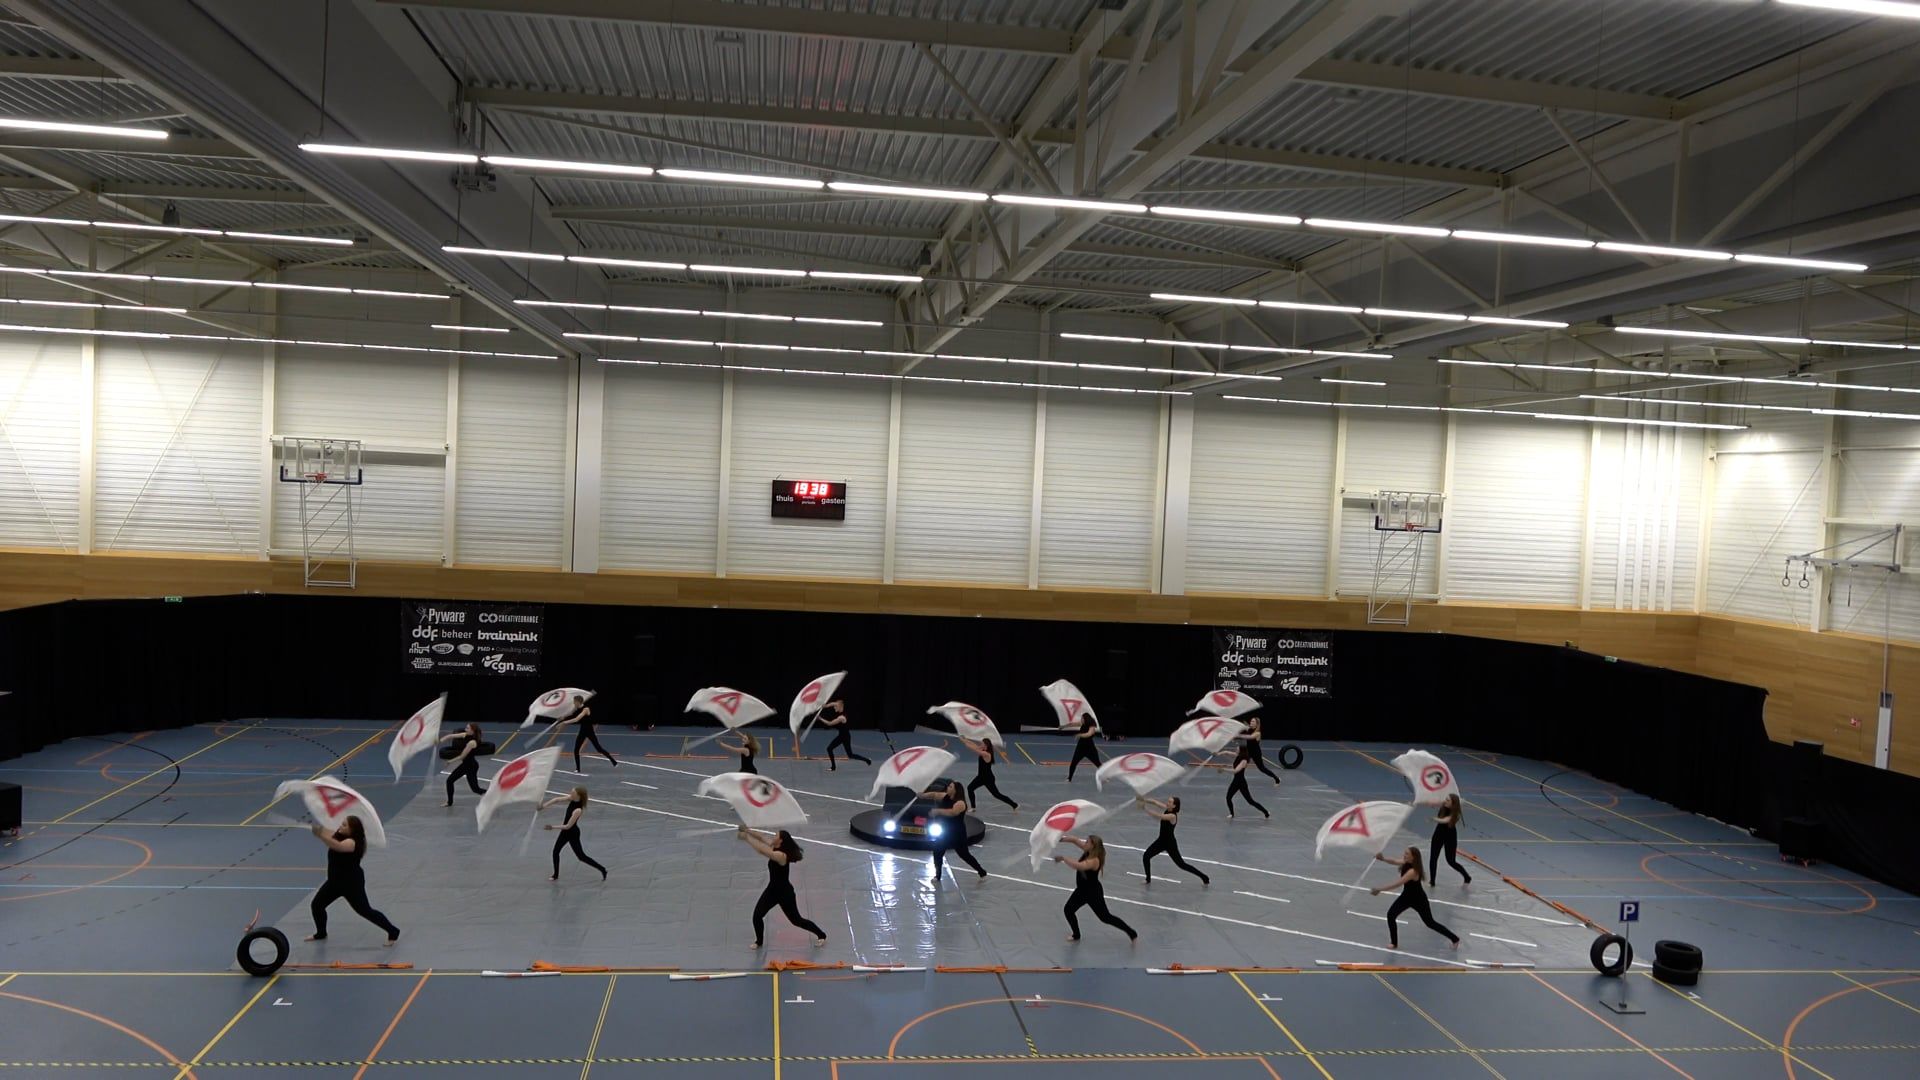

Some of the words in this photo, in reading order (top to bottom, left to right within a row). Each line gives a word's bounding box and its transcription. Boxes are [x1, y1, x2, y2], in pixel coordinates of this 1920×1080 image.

[821, 497, 846, 505] gasten
[428, 608, 465, 624] Pyware
[412, 625, 438, 641] ddf
[441, 629, 473, 639] beheer
[477, 630, 538, 642] brainpink
[1236, 635, 1267, 650] Pyware
[1221, 650, 1244, 666] ddf
[1246, 655, 1273, 664] beheer
[1277, 655, 1328, 667] brainpink
[491, 661, 514, 673] cgn
[1288, 684, 1308, 695] cgn
[1623, 903, 1636, 921] P
